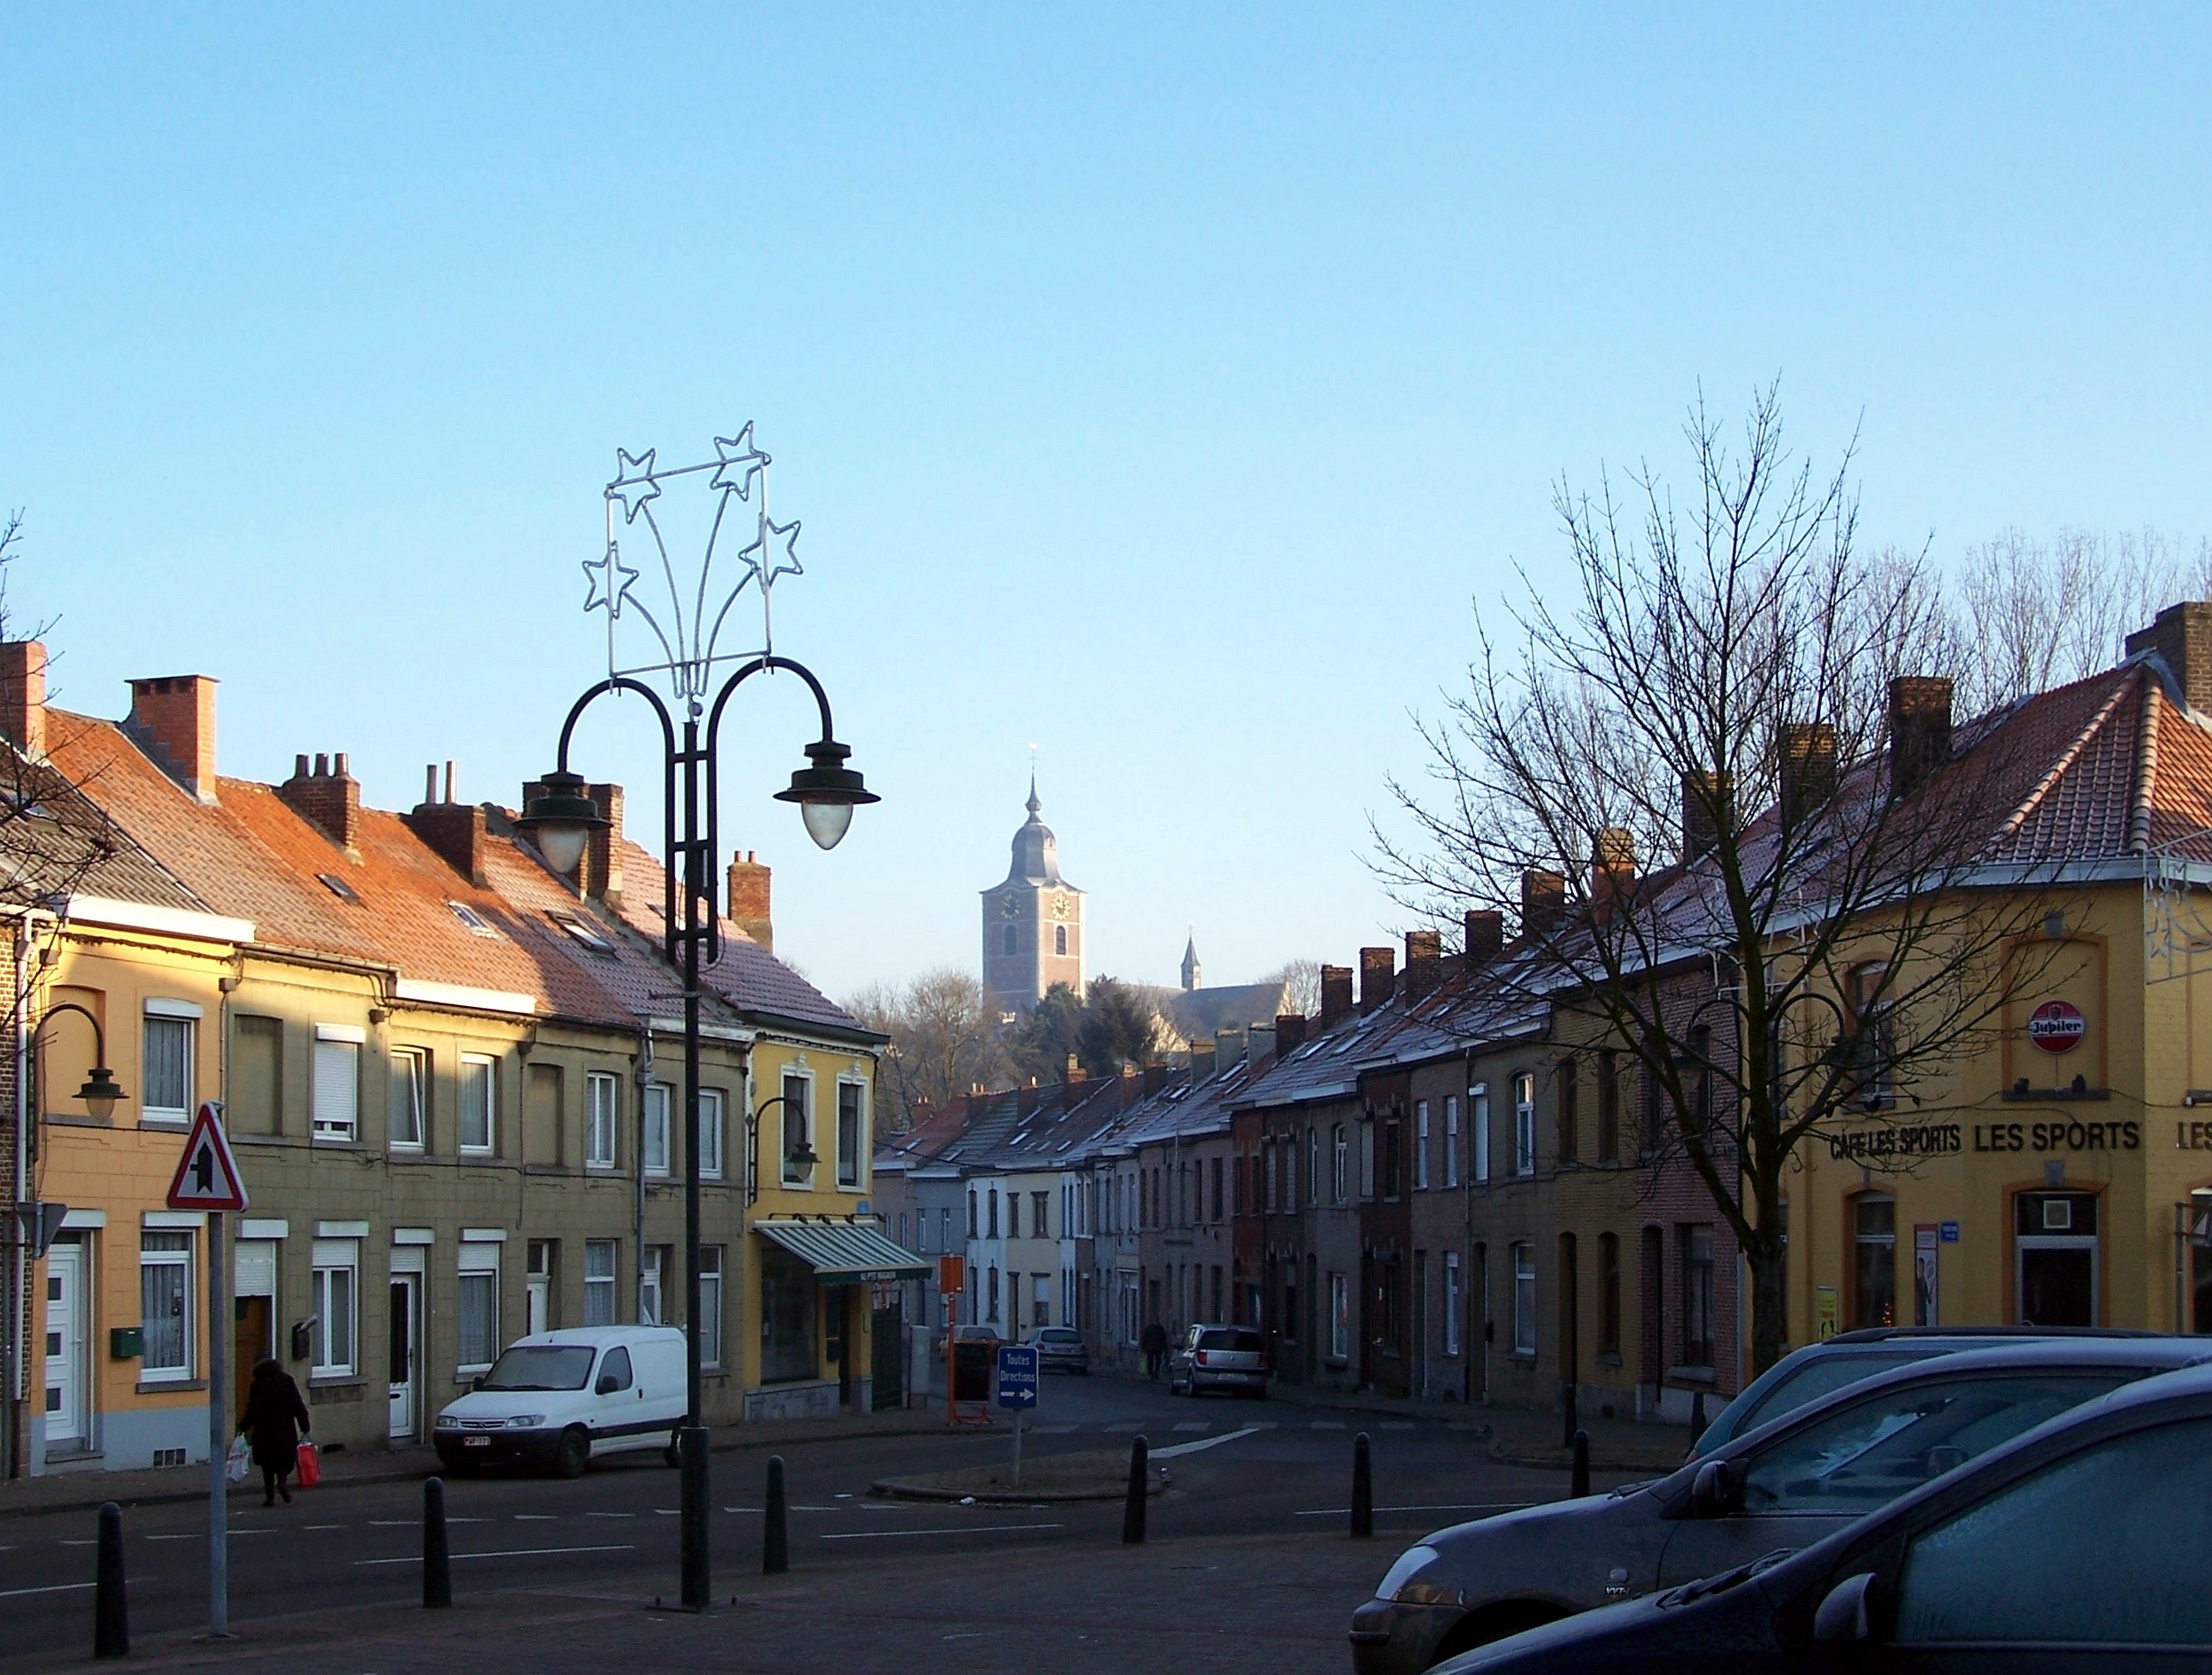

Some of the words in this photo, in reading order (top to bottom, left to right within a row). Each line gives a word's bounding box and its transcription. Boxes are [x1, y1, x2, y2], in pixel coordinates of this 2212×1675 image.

[2032, 1021, 2081, 1034] Jupiler
[1869, 1128, 1895, 1155] LES
[1900, 1124, 1961, 1154] SPORTS
[1975, 1123, 2024, 1152] LES
[2032, 1121, 2139, 1151] SPORTS
[1006, 1353, 1030, 1366] Toutes
[1000, 1369, 1035, 1383] Directions
